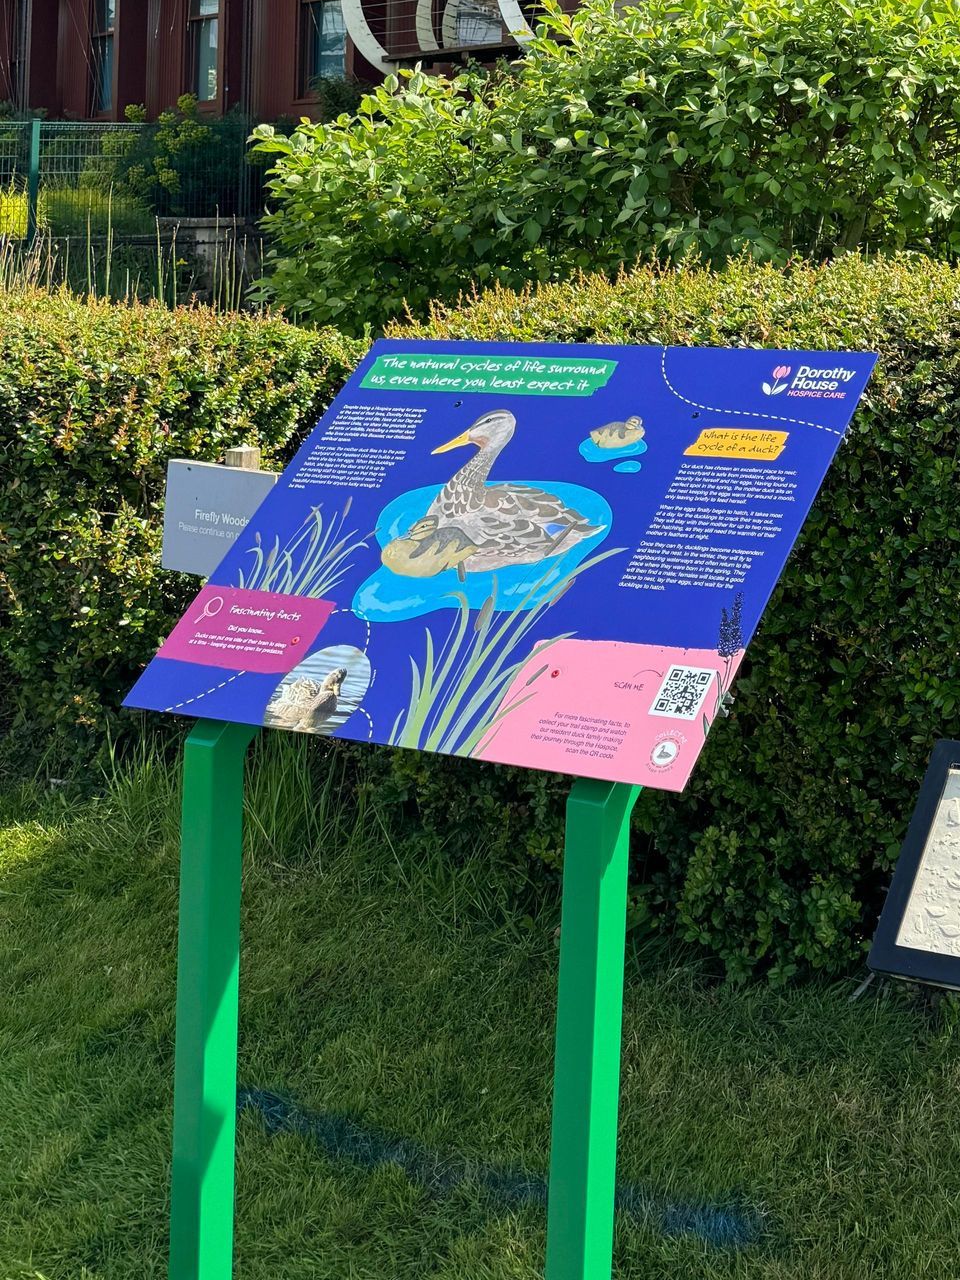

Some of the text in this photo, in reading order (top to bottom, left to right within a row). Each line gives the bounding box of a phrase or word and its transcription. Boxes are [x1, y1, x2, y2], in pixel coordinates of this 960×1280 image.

[384, 358, 607, 374] The natural cycles of life surround
[796, 366, 856, 382] Dorothy
[390, 376, 418, 384] even
[422, 374, 462, 386] where
[463, 379, 486, 388] you
[490, 376, 525, 388] least
[527, 380, 574, 391] expect
[577, 380, 589, 390] it
[791, 378, 838, 390] House
[741, 433, 757, 441] the
[760, 434, 776, 442] life
[698, 443, 724, 451] cycle
[726, 443, 738, 451] of
[195, 508, 220, 524] Firefly
[178, 521, 198, 533] Please
[199, 526, 224, 538] continue
[226, 531, 235, 539] on
[230, 605, 301, 621] Fascinating facts
